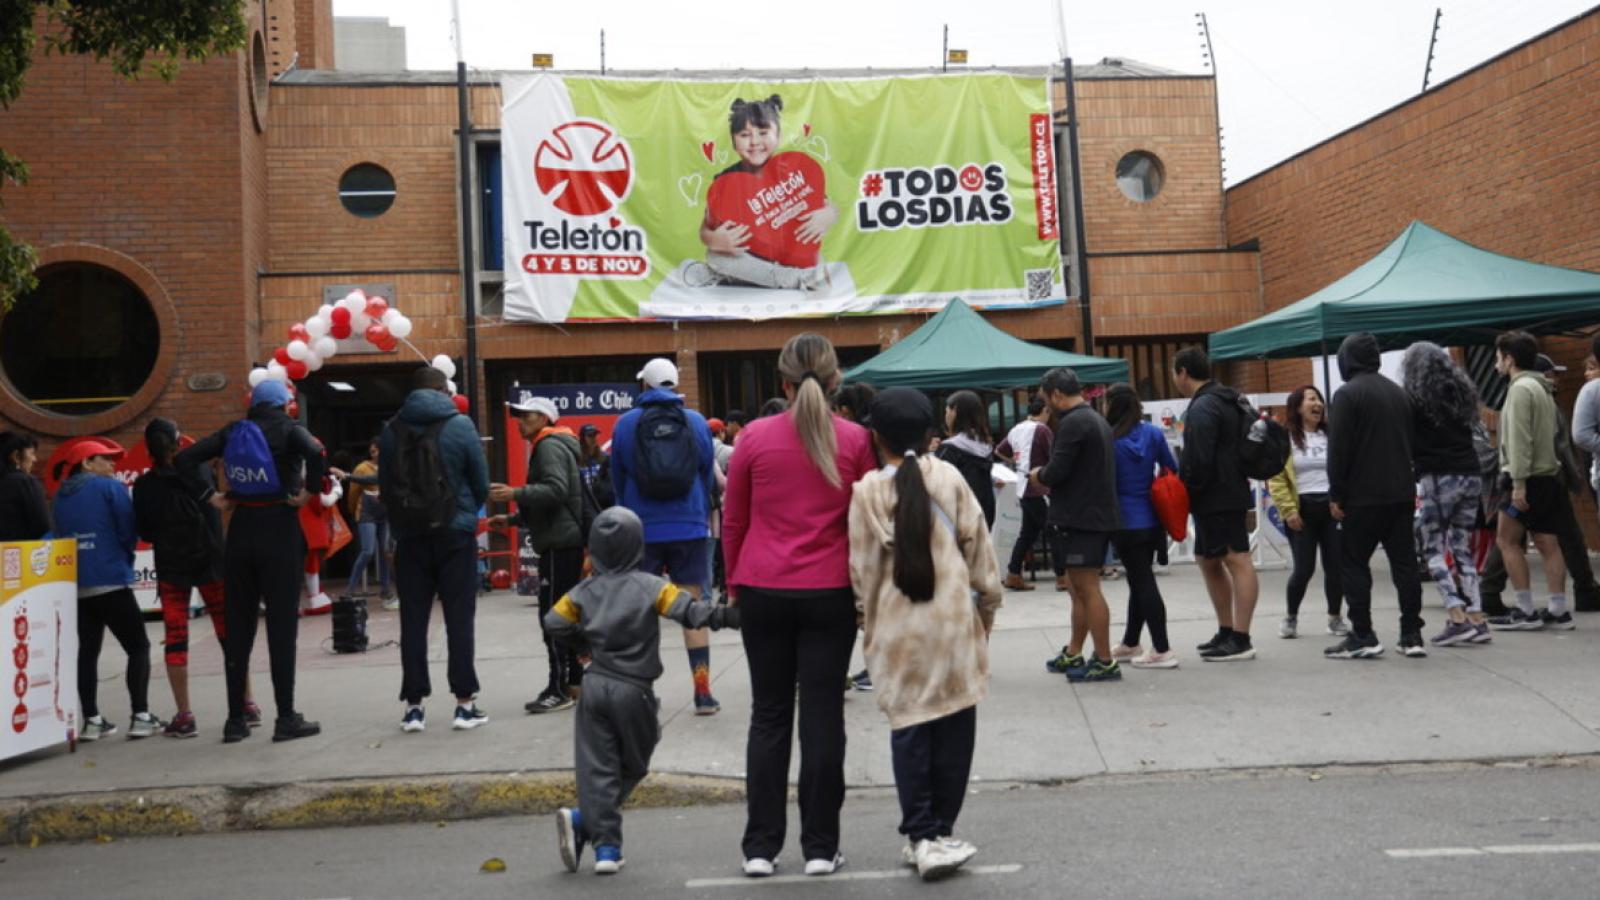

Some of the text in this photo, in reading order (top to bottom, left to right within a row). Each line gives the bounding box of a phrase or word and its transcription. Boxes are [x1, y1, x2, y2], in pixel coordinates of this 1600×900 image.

[863, 164, 1004, 197] #TODOS
[859, 194, 1011, 229] LOSDIAS
[527, 257, 640, 272] 4 Y 5 DE NOV
[520, 390, 633, 410] Bco de Chile
[225, 464, 269, 483] USM
